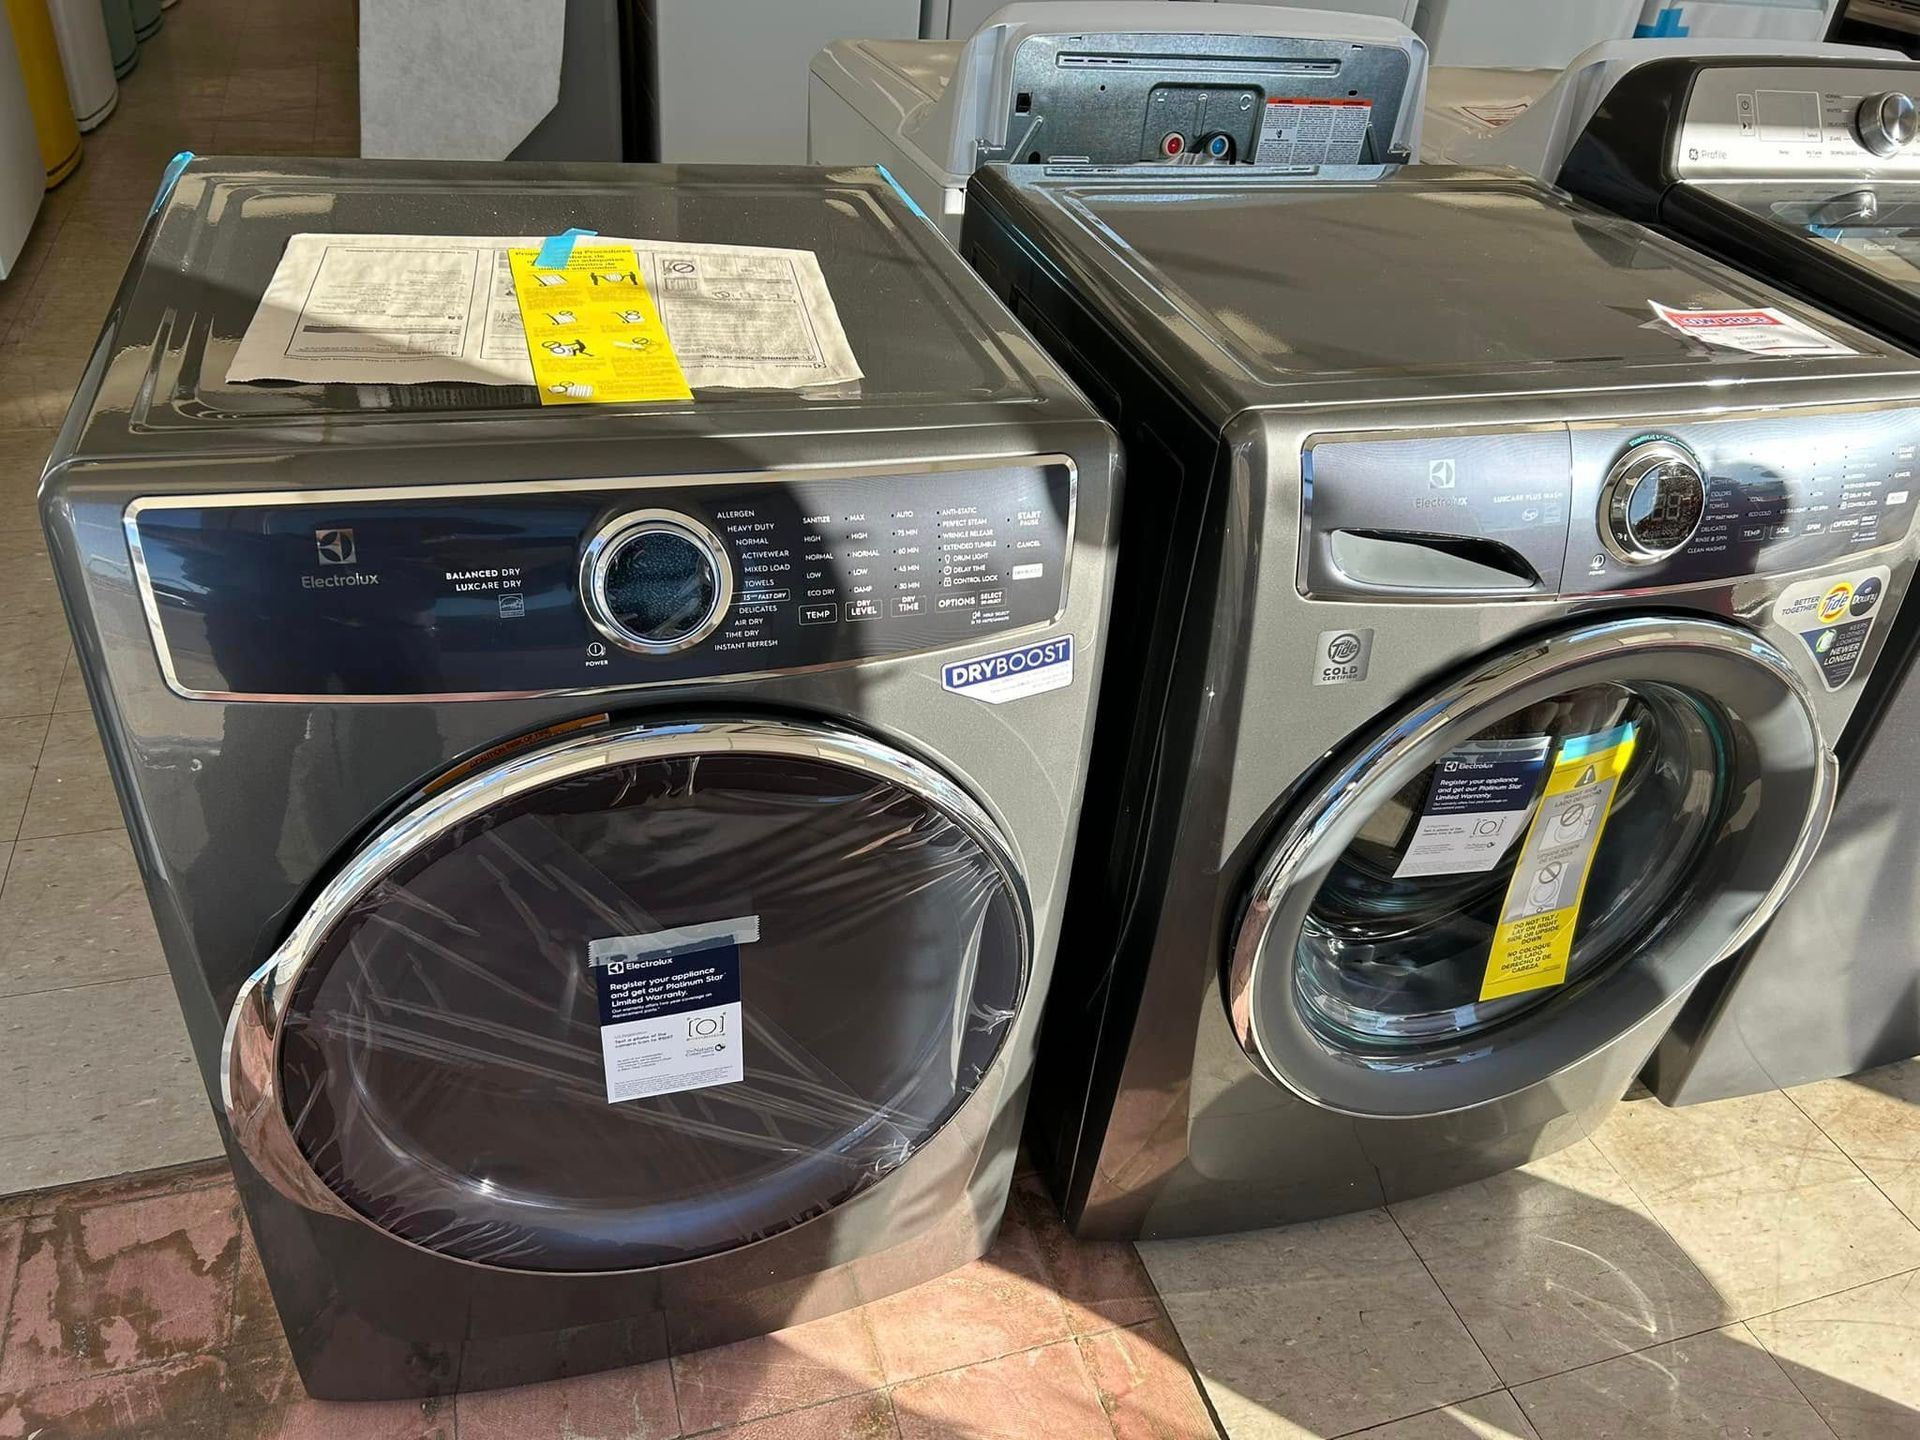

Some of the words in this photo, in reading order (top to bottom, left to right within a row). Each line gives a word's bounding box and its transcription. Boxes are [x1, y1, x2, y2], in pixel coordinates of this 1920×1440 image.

[1701, 150, 1728, 160] Profile
[1416, 496, 1468, 508] Electrolux
[717, 510, 755, 519] ALLERGEN
[1018, 511, 1041, 520] START
[802, 516, 831, 524] SANITIZE
[1833, 519, 1859, 528] OPTIONS
[727, 524, 752, 532] HEAVY
[754, 523, 775, 531] DUTY
[851, 532, 868, 540] HIGH
[736, 538, 768, 546] NORMAL
[742, 550, 790, 559] ACTIVEWEAR
[805, 552, 834, 560] NORMAL
[852, 550, 880, 558] NORMAL
[953, 554, 972, 562] DRUM
[972, 552, 988, 560] LIGHT
[770, 564, 790, 572] LOAD
[852, 568, 868, 576] LOW
[953, 566, 972, 574] DELAY
[972, 564, 986, 572] TIME
[446, 569, 499, 580] BALANCED
[501, 568, 521, 578] DRY
[953, 576, 980, 584] CONTROL
[982, 574, 998, 582] LOCK
[301, 571, 380, 590] Electrolux
[456, 580, 500, 592] LUXCARE
[502, 579, 522, 589] DRY
[744, 579, 774, 587] TOWELS
[822, 588, 836, 596] DRY
[854, 586, 873, 594] DAMP
[980, 592, 1002, 600] SELECT
[1794, 596, 1820, 606] BETTER
[1852, 592, 1878, 604] Downy
[856, 600, 871, 608] DRY
[898, 602, 919, 612] TIME
[938, 598, 976, 608] OPTIONS
[1820, 592, 1849, 618] Tide
[739, 605, 778, 614] DELICATES
[851, 606, 878, 616] LEVEL
[1782, 604, 1818, 616] TOGETHER
[806, 610, 830, 620] TEMP
[749, 618, 764, 626] DRY
[744, 630, 760, 638] DRY
[714, 642, 746, 650] INSTANT
[747, 640, 778, 648] REFRESH
[1331, 640, 1358, 660] Tide
[1830, 644, 1860, 656] NEWER
[585, 660, 608, 668] POWER
[952, 641, 1067, 687] DRYBOOST
[1824, 652, 1858, 666] LONGER
[1324, 666, 1358, 676] COLD
[1452, 786, 1464, 794] get
[1514, 922, 1524, 930] DO
[1524, 918, 1539, 926] NOT
[1536, 920, 1558, 928] RIGHT
[1507, 934, 1522, 942] SIDE
[1534, 924, 1560, 936] UPSIDE
[1521, 936, 1542, 944] DOWN
[1507, 950, 1518, 958] NO
[1518, 942, 1551, 954] COLOQUE
[1524, 950, 1542, 958] LADO
[626, 958, 673, 970] Electrolux
[1500, 958, 1534, 970] DERECHO
[1512, 962, 1538, 974] CABEZA
[610, 980, 647, 992] Register
[649, 977, 670, 986] your
[672, 966, 716, 980] appliance
[610, 990, 628, 1000] and
[632, 988, 646, 998] get
[648, 986, 664, 994] our
[666, 978, 704, 990] Platinum
[612, 996, 644, 1008] Limited
[645, 990, 688, 1002] Warranty.
